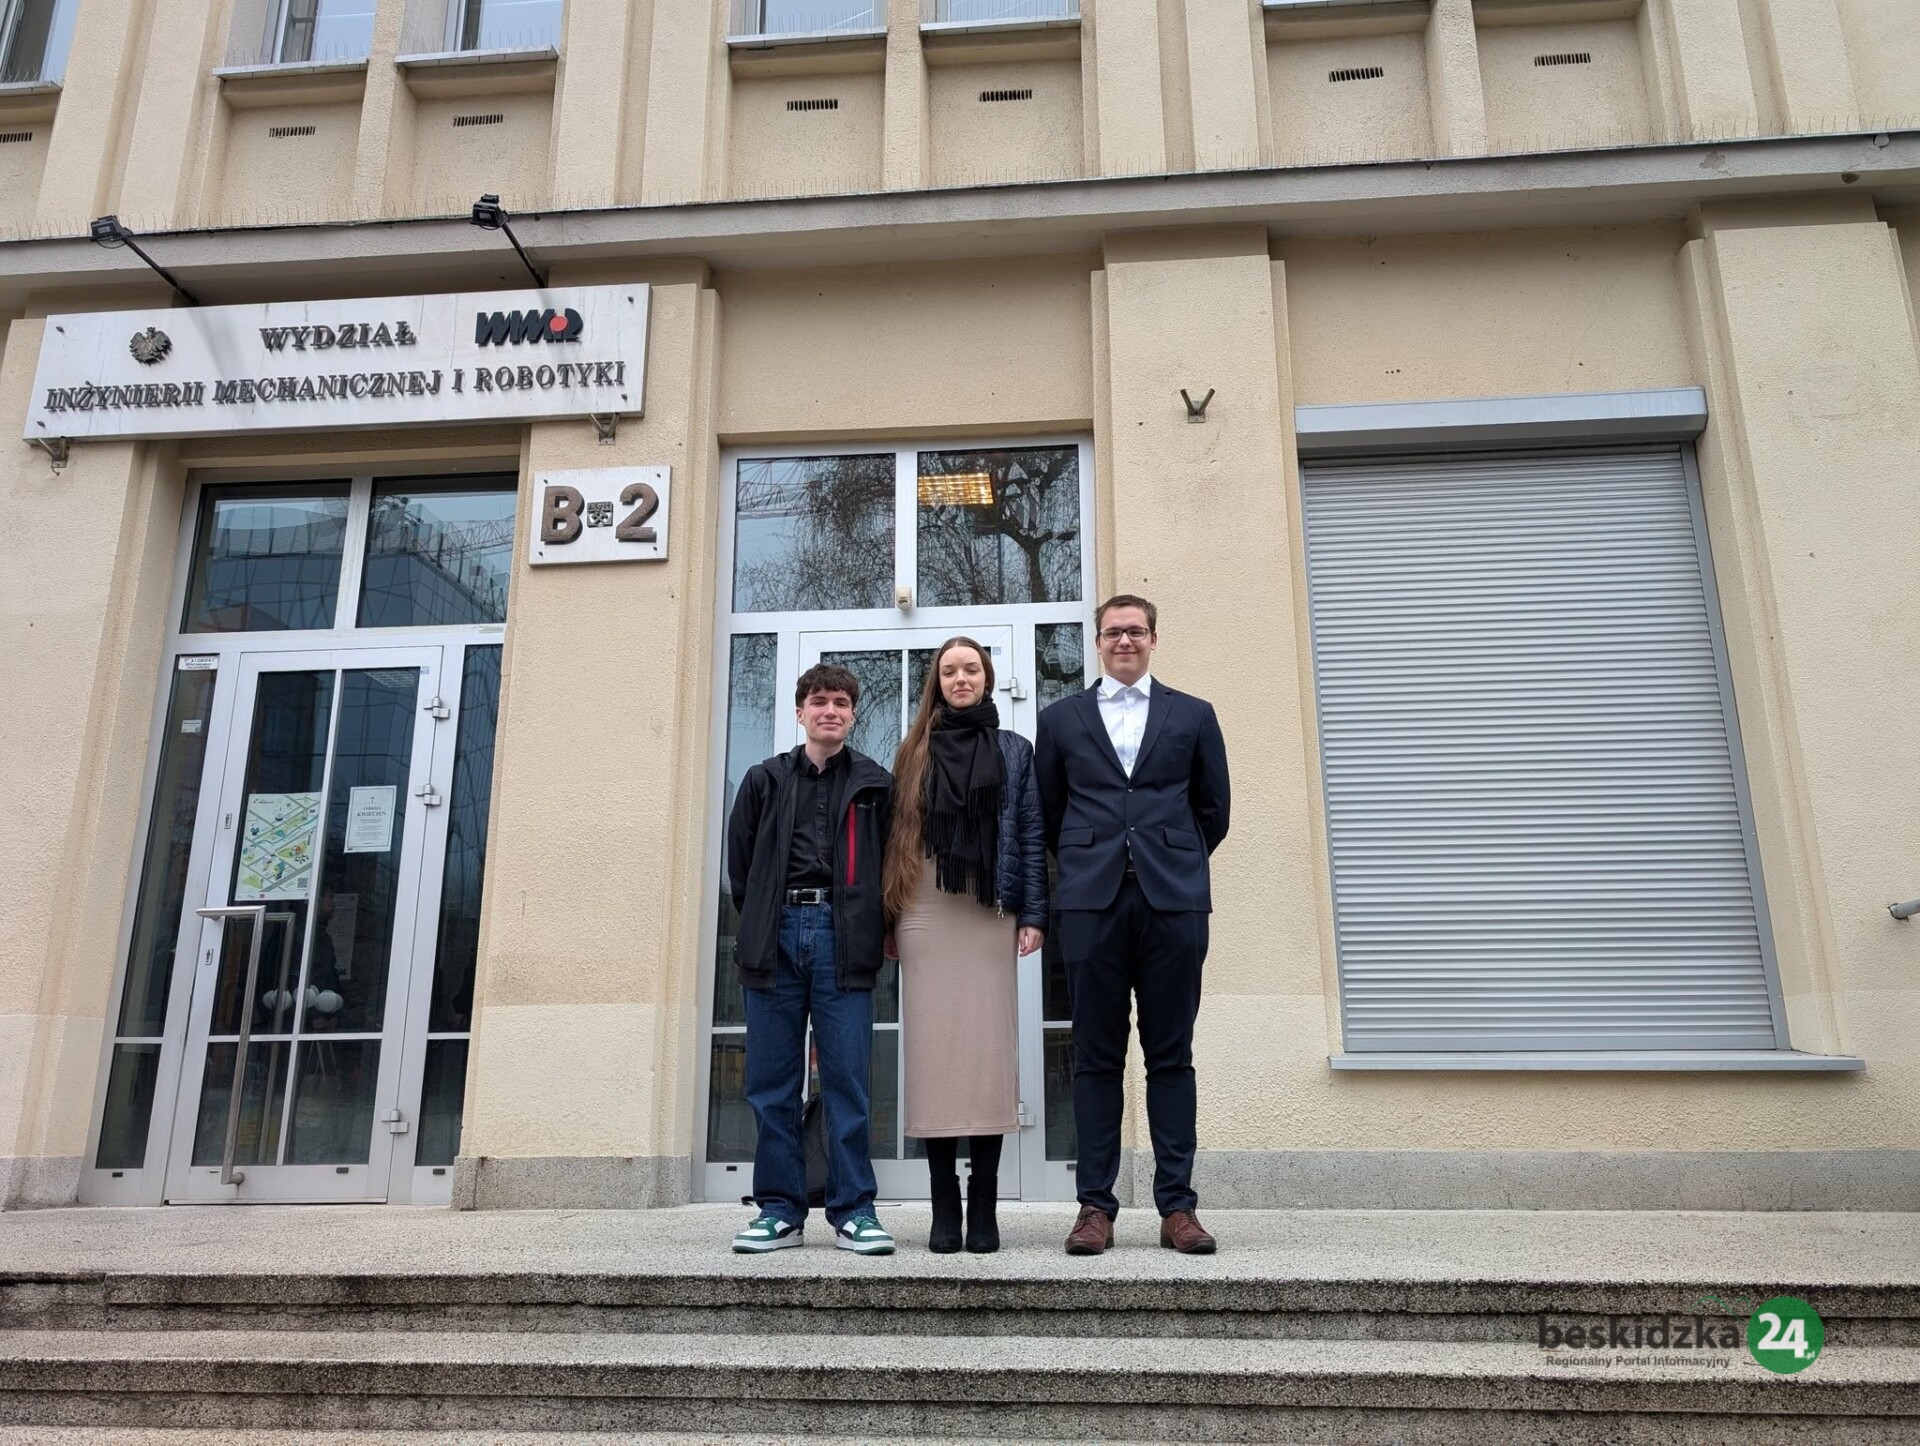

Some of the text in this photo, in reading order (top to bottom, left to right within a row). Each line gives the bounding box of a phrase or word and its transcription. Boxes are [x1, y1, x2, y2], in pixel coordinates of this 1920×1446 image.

[259, 321, 416, 350] WYDZIAŁ
[44, 361, 625, 412] INŻYNIERII MECHANICZNEJ I ROBOTYKI
